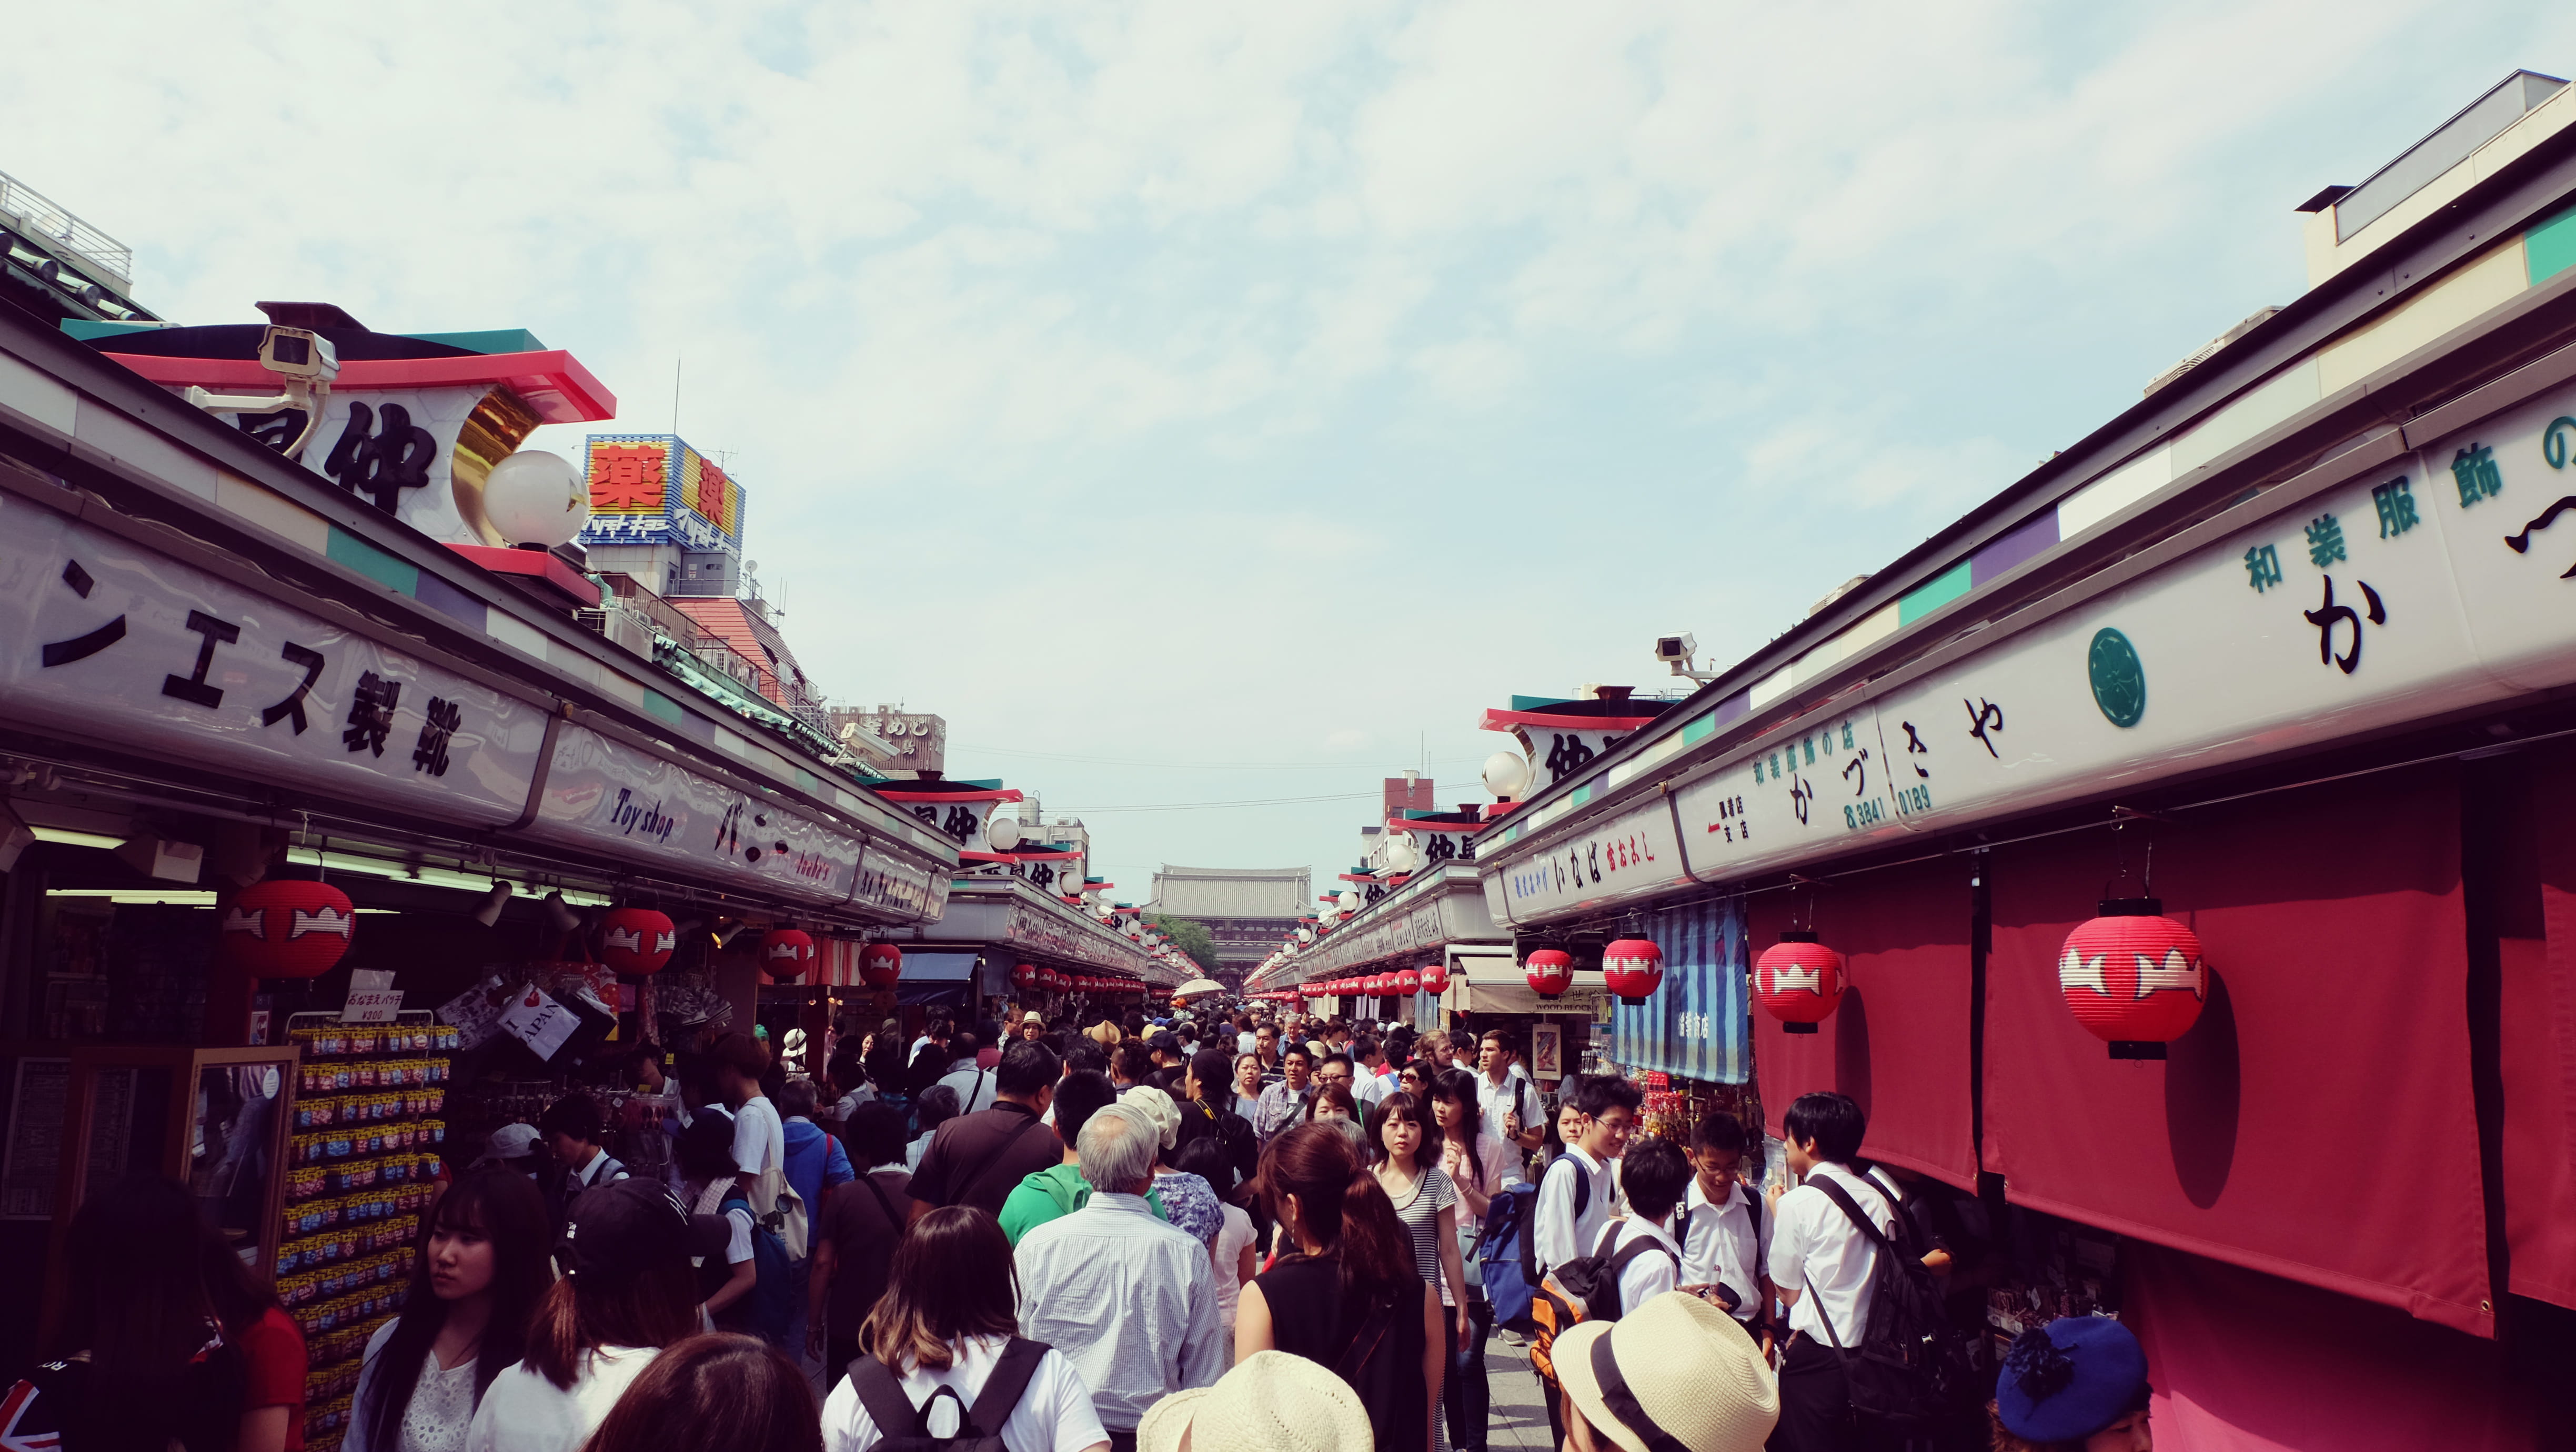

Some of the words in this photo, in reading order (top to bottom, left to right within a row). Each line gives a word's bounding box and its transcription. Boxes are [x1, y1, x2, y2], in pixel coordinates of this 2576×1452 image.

[589, 445, 666, 509] 薬
[698, 457, 727, 526] 薬
[42, 558, 462, 778] ンエス製靴
[1753, 719, 1855, 786] 和装服飾の店
[1789, 697, 2003, 825] かづさや
[610, 788, 642, 835] Toy
[640, 800, 674, 844] shop
[1724, 819, 1749, 843] 支店
[1856, 796, 1887, 826] 3841
[1898, 783, 1930, 816] 0189
[1553, 840, 1602, 894] いなば
